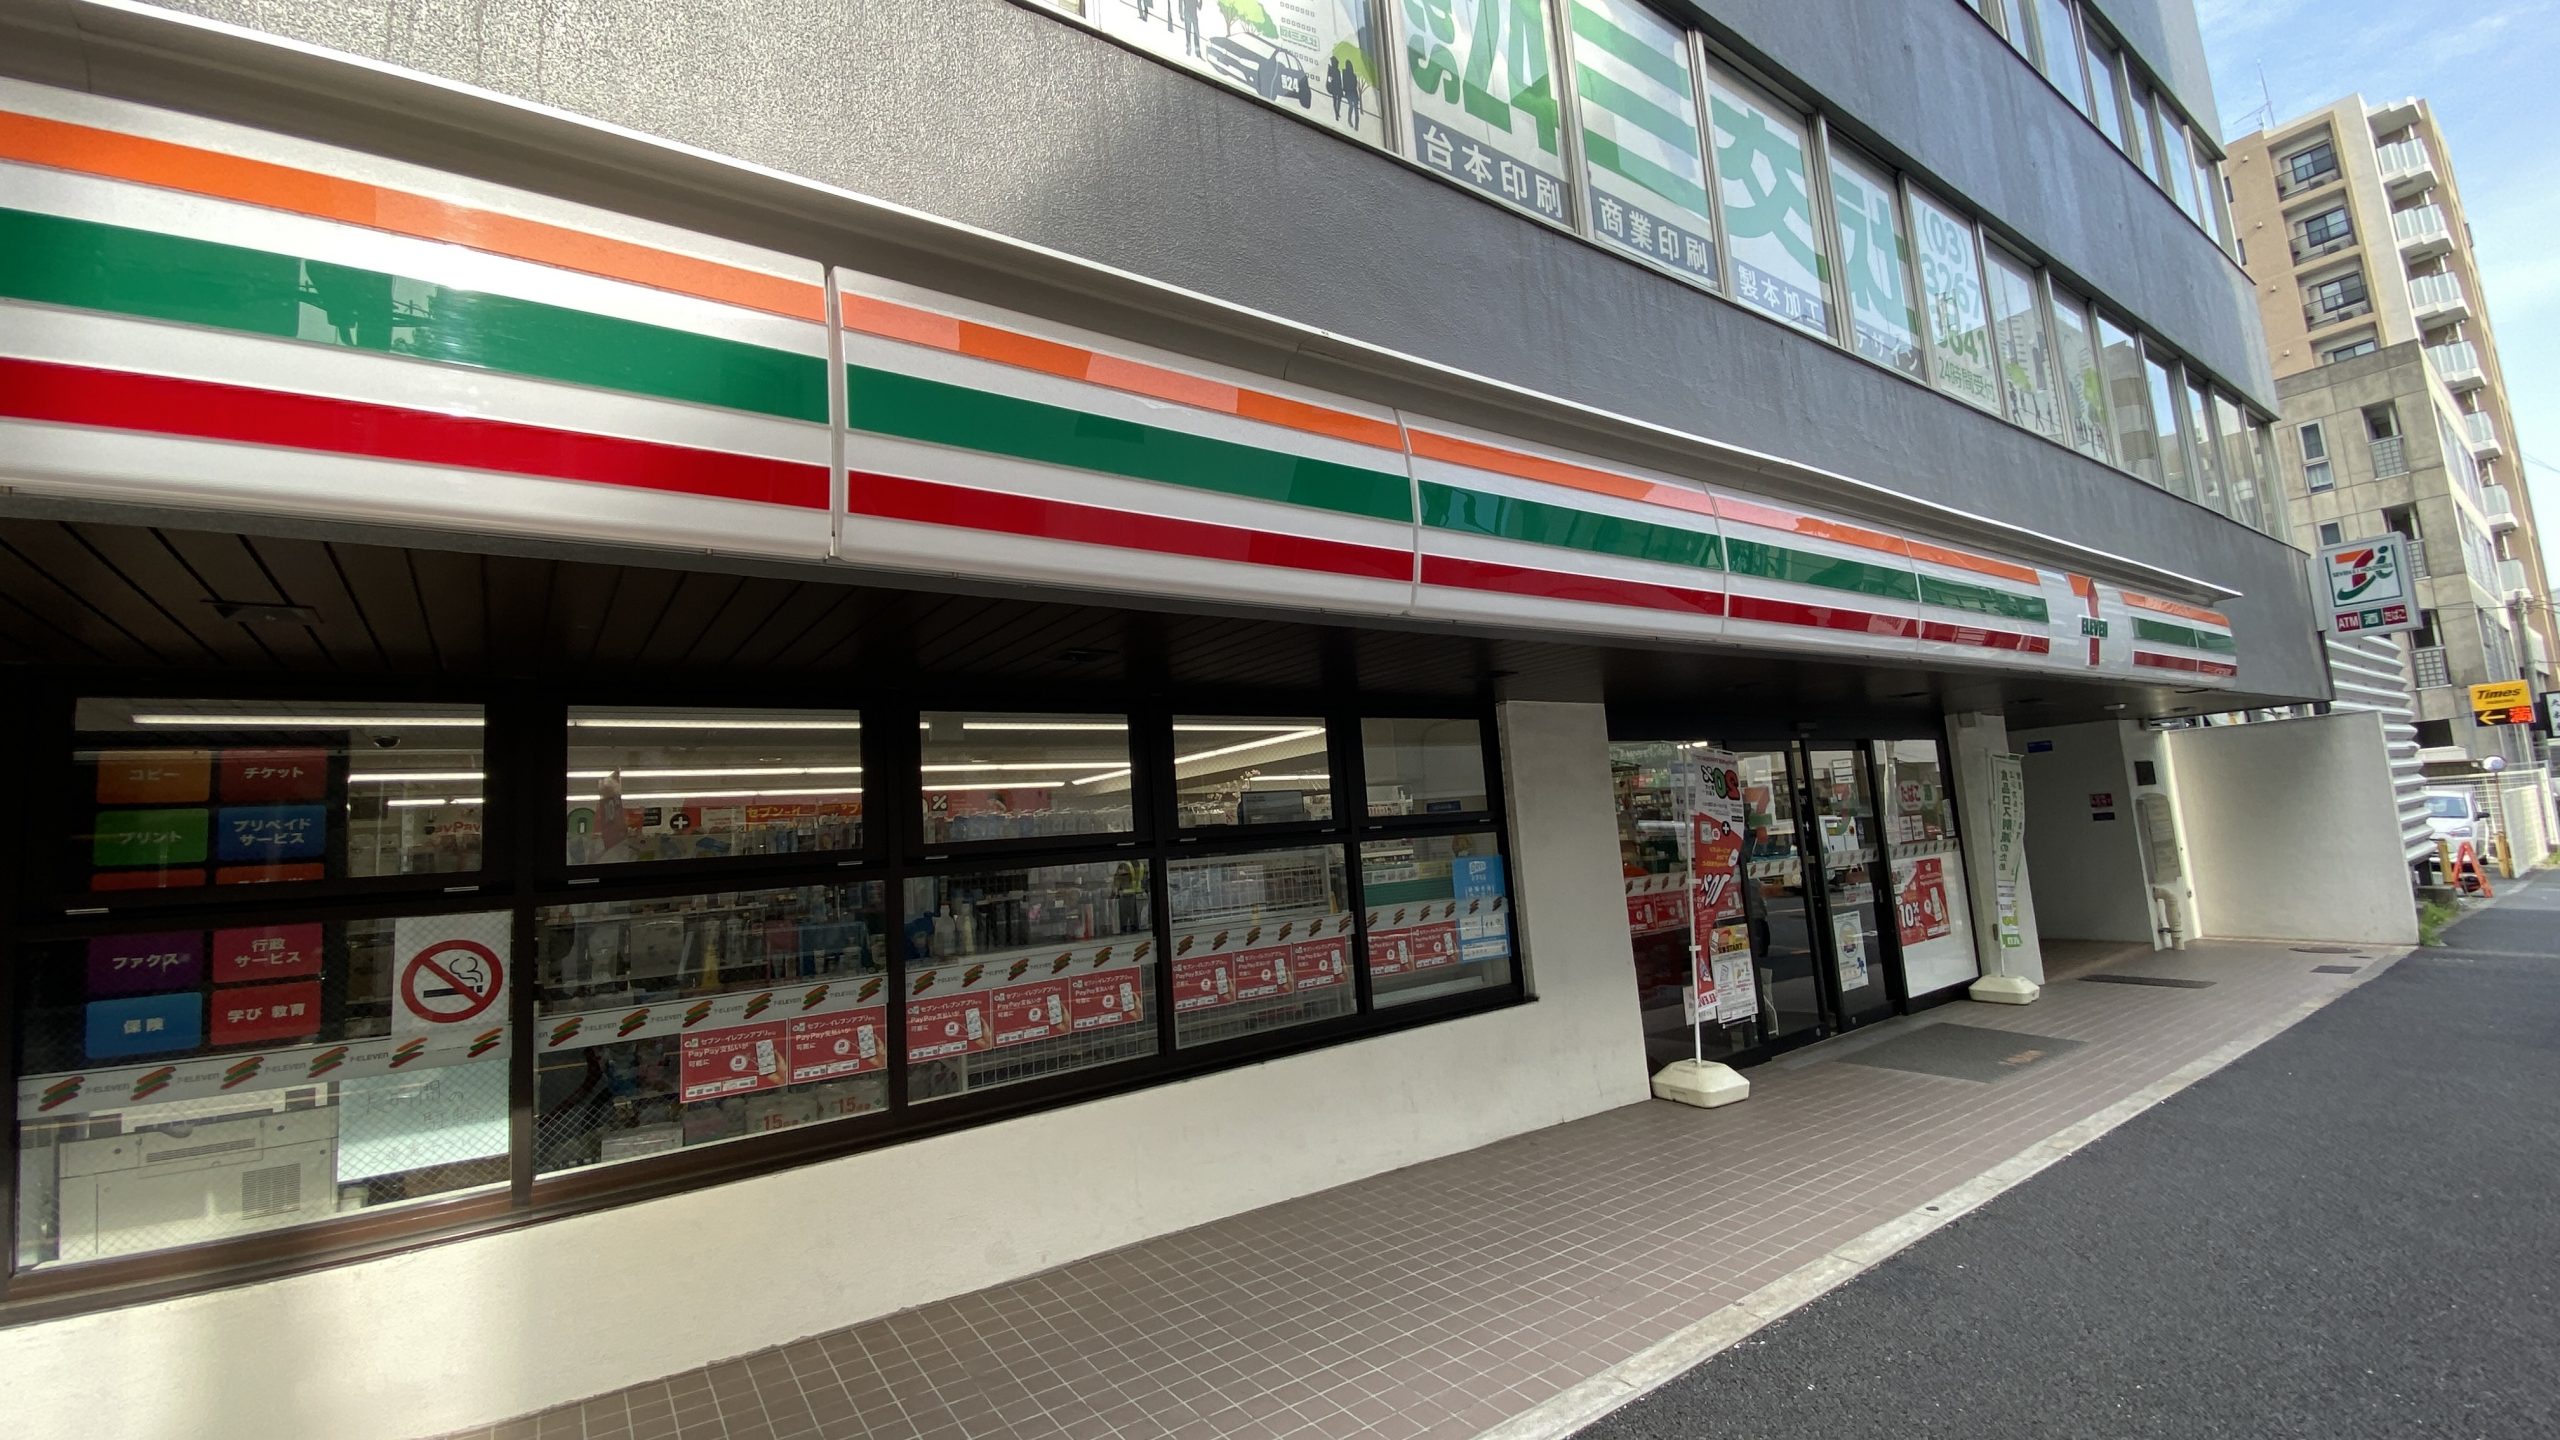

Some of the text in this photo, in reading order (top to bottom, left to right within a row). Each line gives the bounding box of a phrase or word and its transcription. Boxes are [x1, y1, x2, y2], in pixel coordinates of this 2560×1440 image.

[1423, 125, 1563, 219] 台本印刷
[1599, 197, 1709, 276] 商業印刷
[1922, 206, 1968, 273] (03)
[1738, 264, 1823, 328] 製本加工
[1856, 325, 1918, 372] デザイン
[1938, 356, 1997, 403] 24時間受付
[2338, 615, 2359, 629] ATM
[2477, 688, 2521, 700] Times
[129, 769, 181, 782] コピー
[243, 767, 305, 780] チケット
[233, 817, 312, 832] プリペイド
[119, 830, 183, 844] プリント
[240, 832, 305, 847] サービス
[251, 937, 287, 953] 行政
[112, 953, 180, 970] ファクス
[234, 952, 302, 969] サービス
[227, 1002, 306, 1023] 学び 教育
[122, 1016, 165, 1035] 保険
